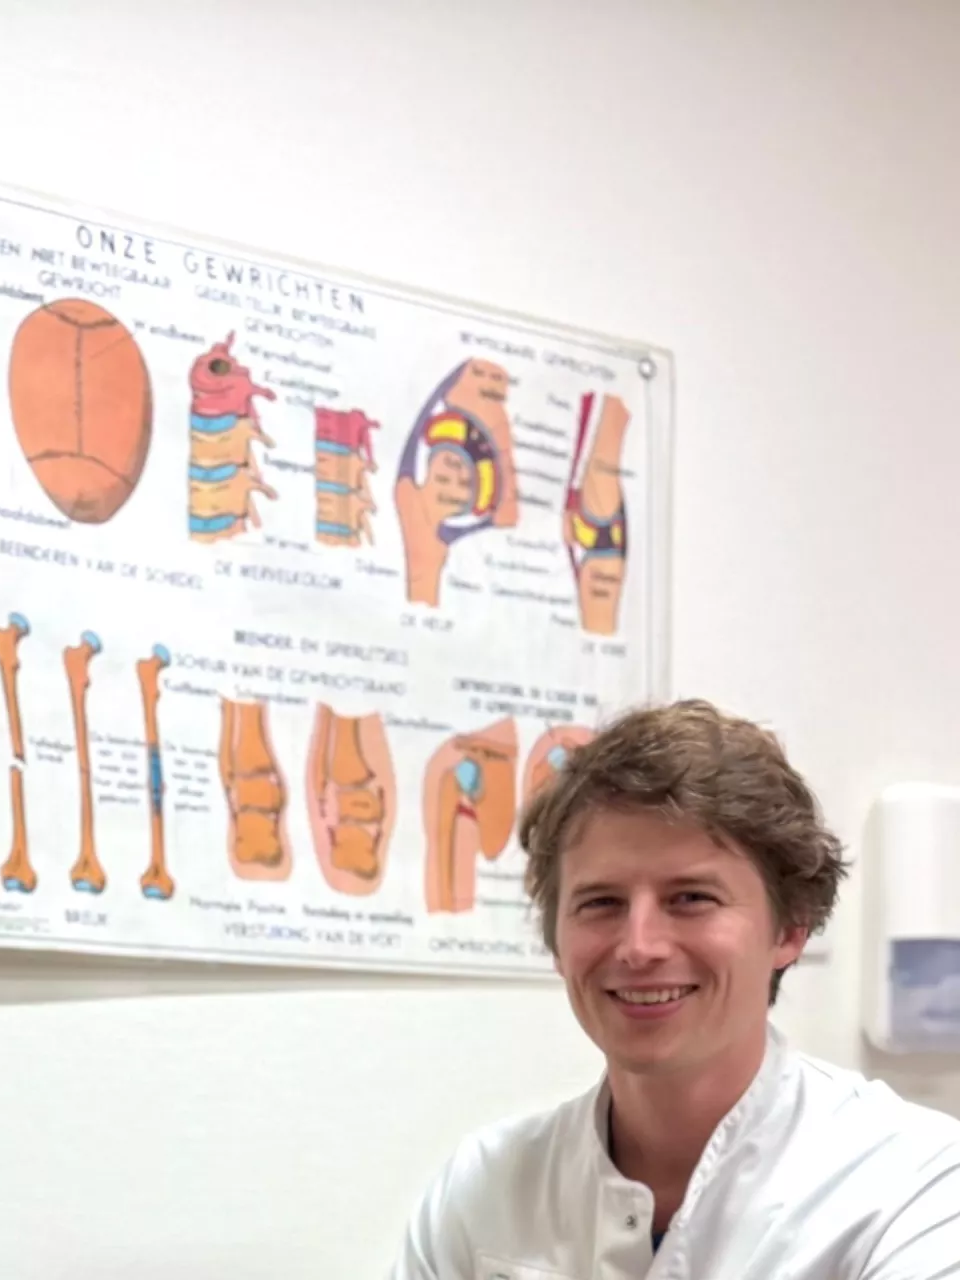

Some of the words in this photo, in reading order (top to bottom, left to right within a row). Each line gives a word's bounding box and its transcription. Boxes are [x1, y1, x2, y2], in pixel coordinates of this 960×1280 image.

[37, 269, 122, 300] GEWRICHT
[76, 224, 156, 264] ONZE
[183, 251, 365, 314] GEWRICHTEN
